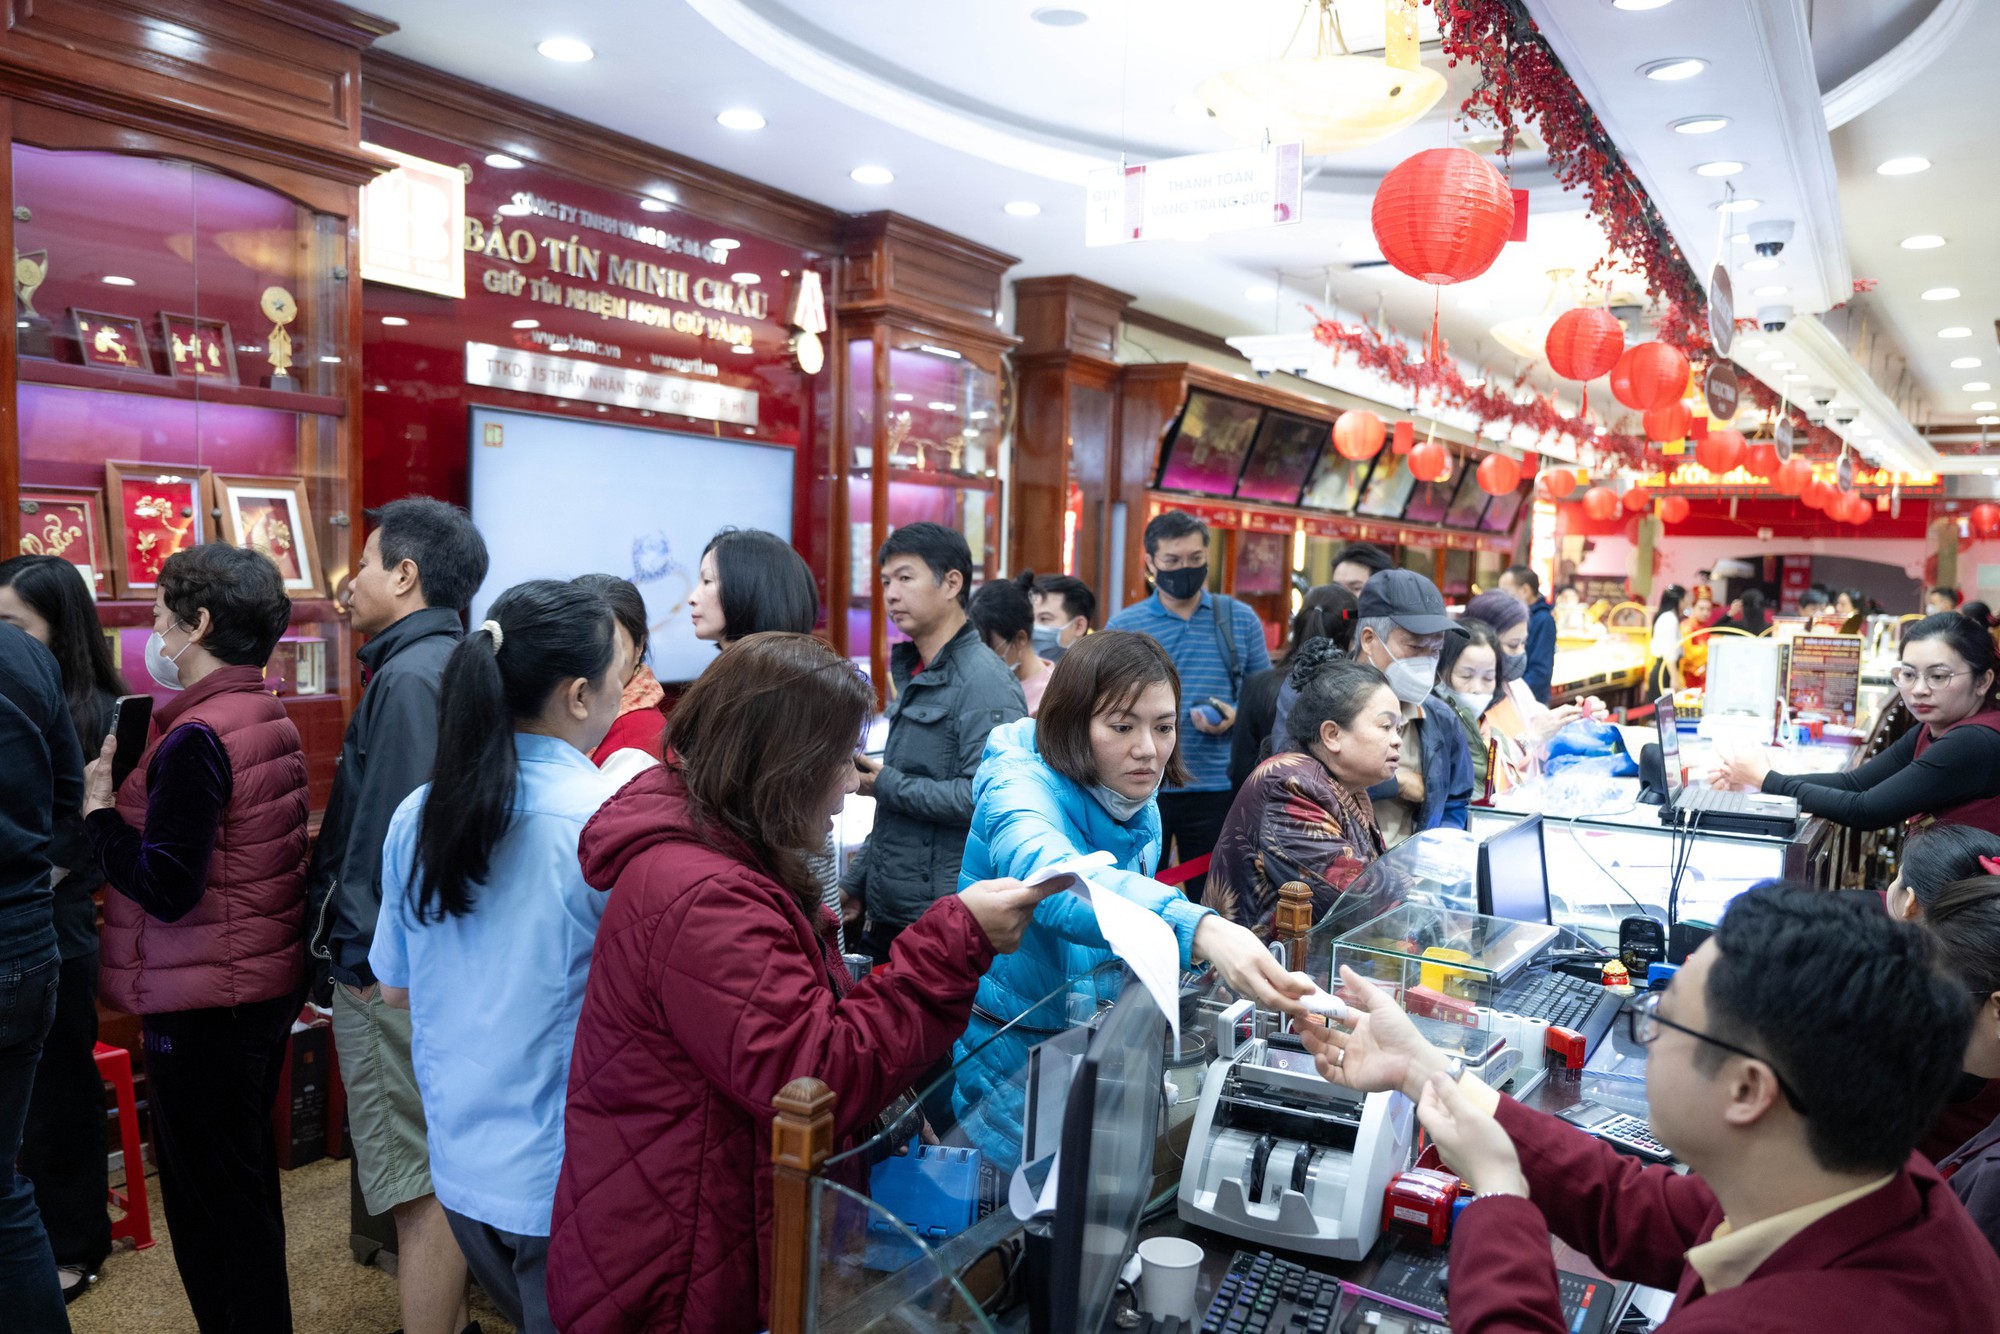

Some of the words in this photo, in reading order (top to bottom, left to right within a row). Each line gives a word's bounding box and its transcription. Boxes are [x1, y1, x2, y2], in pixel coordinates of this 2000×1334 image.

[558, 205, 578, 223] TY
[464, 213, 537, 264] BẢO
[541, 234, 601, 282] TÍN
[606, 253, 690, 303] MINH
[693, 277, 769, 321] CHÂU
[483, 269, 526, 297] GIỮ
[528, 275, 562, 305] TÍN
[672, 310, 706, 337] GIỮ
[705, 316, 753, 347] VÀNG
[485, 358, 528, 379] TTKD:
[531, 366, 547, 382] 15
